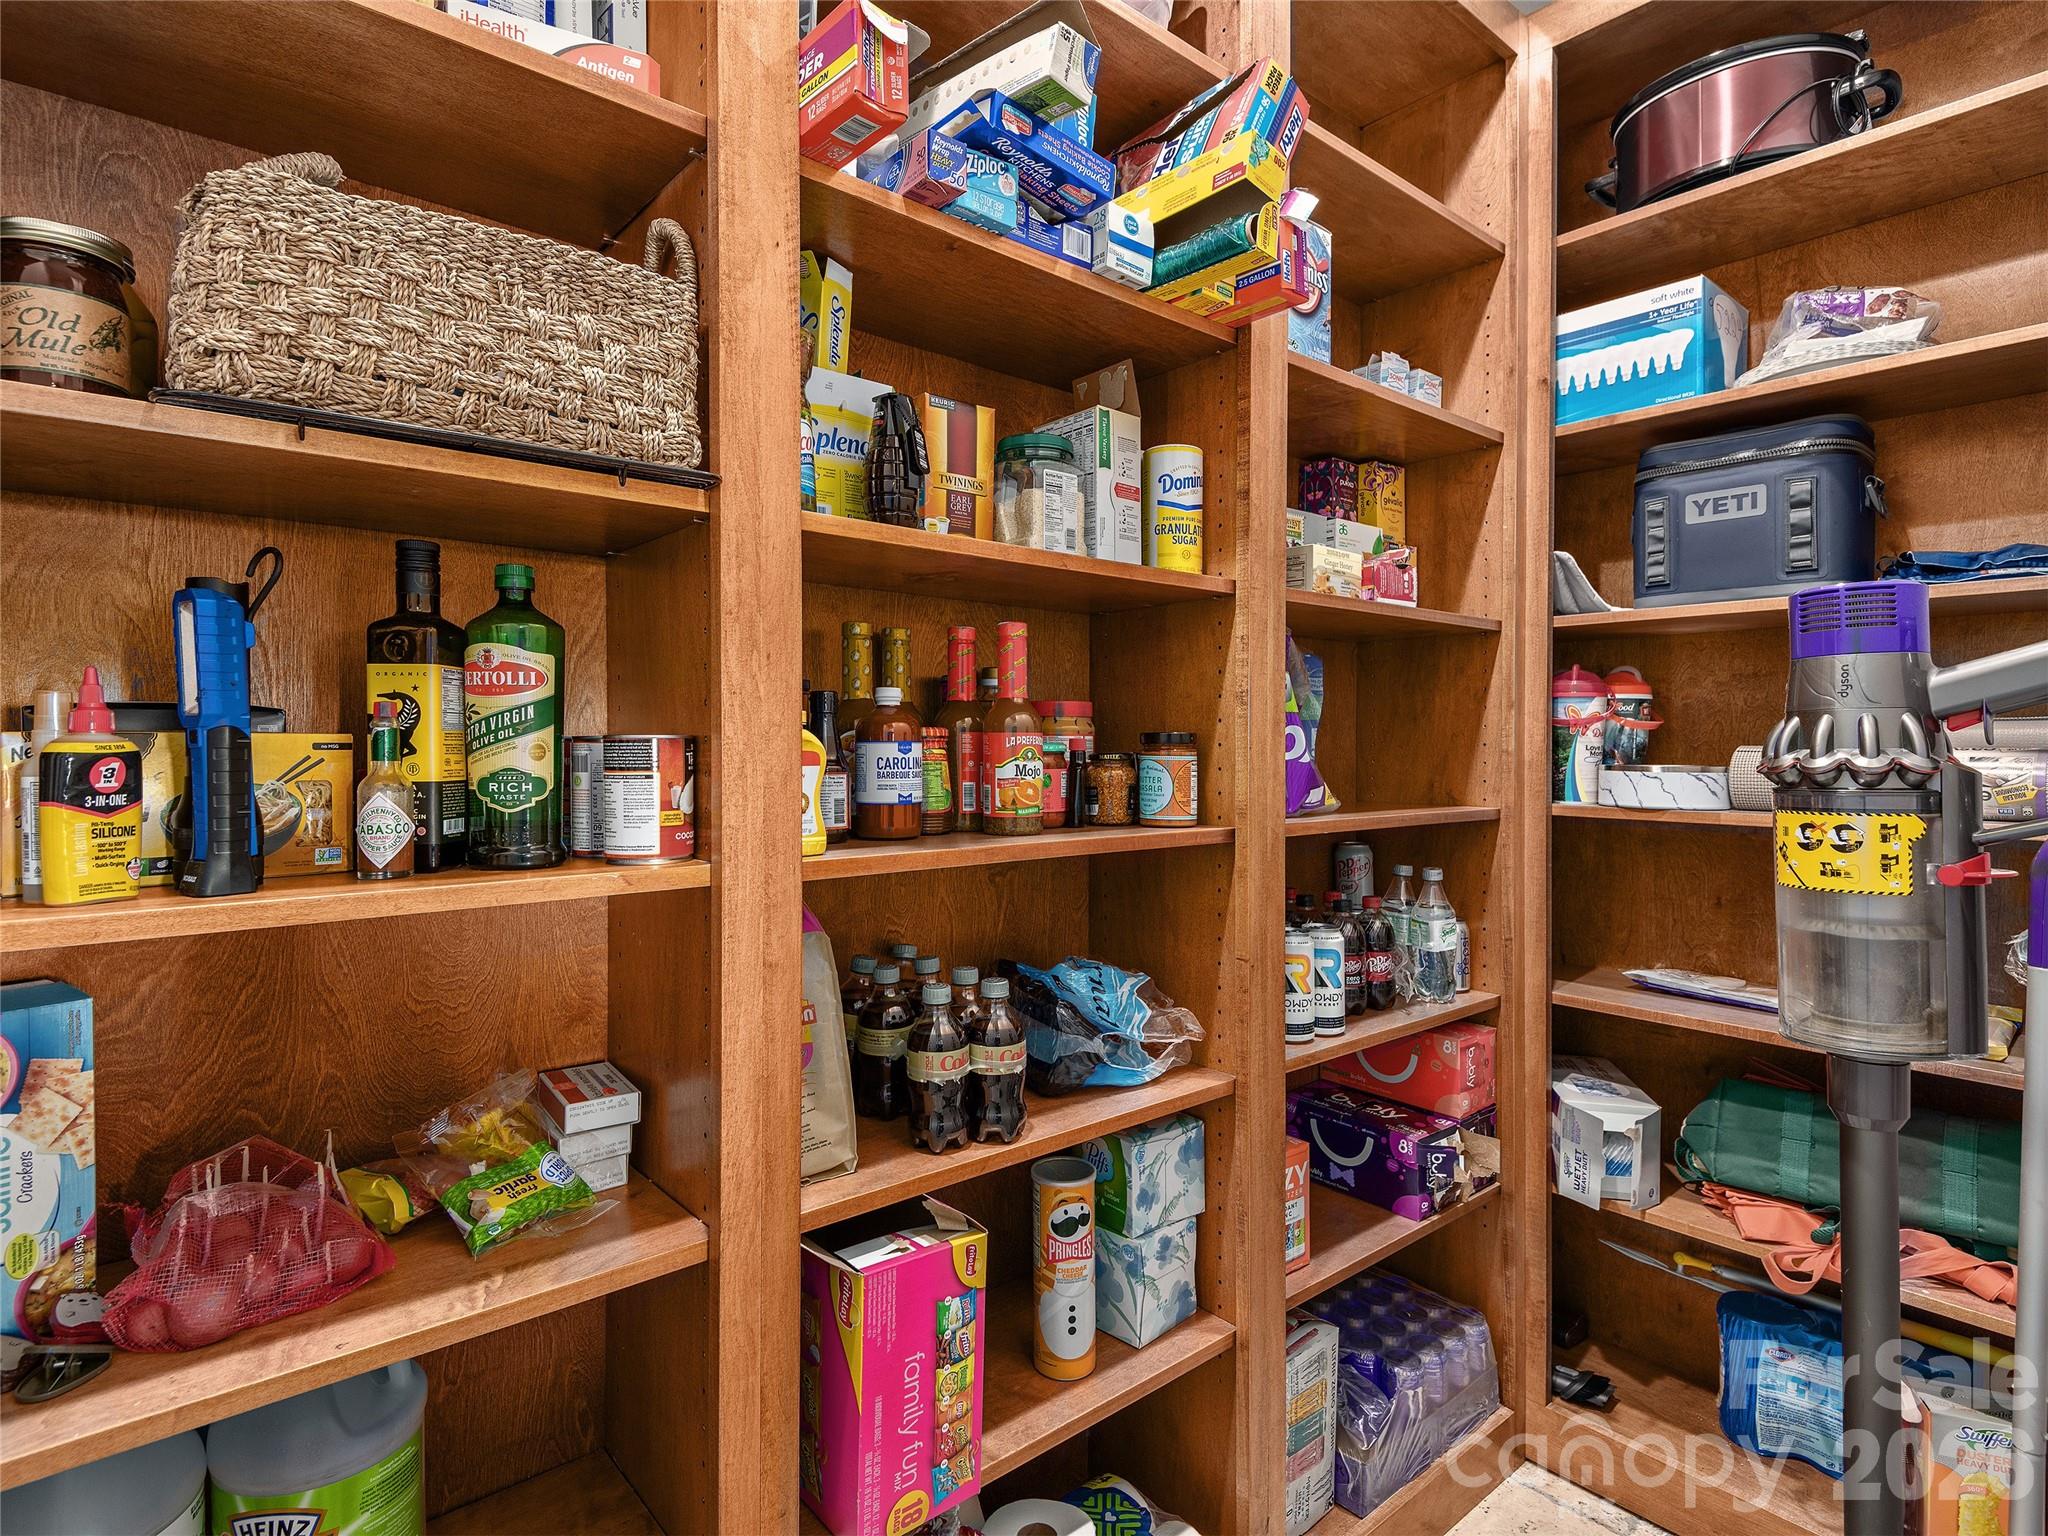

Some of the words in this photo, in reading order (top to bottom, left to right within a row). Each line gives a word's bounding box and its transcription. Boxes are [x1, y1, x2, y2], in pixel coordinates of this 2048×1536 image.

[460, 9, 526, 43] iHealth
[576, 56, 635, 84] Antigen
[1265, 65, 1277, 89] PACK
[801, 70, 829, 98] GALLON
[1270, 69, 1284, 96] MEGA
[807, 104, 816, 121] 12
[1280, 108, 1302, 157] Hefty
[931, 144, 950, 159] Wrap
[934, 135, 964, 155] Reynolds
[1062, 144, 1087, 164] Baking
[930, 152, 955, 167] HEAVY
[967, 153, 1006, 178] Ziploc
[992, 136, 1053, 177] Reynolds
[949, 171, 965, 187] 50
[1008, 156, 1056, 188] KITCHENS
[1077, 164, 1111, 192] Reynolds
[1047, 190, 1079, 213] Sheets
[1093, 208, 1107, 226] 28
[1282, 250, 1292, 283] Hefty
[1238, 278, 1248, 288] 2.5
[1248, 268, 1276, 284] GALLON
[1650, 293, 1668, 305] soft
[1669, 287, 1695, 300] white
[18, 306, 82, 334] Old
[1648, 311, 1658, 319] 1+
[1659, 304, 1679, 317] Year
[830, 294, 846, 367] Splenda
[0, 326, 88, 357] Mule
[1388, 372, 1405, 383] SONIC
[1424, 378, 1440, 389] SONIC
[930, 396, 955, 407] KEURIG
[1655, 393, 1682, 403] Directional
[811, 416, 870, 457] plen
[938, 472, 984, 492] TWININGS
[949, 493, 972, 505] EARL
[949, 501, 973, 514] GREY
[1691, 491, 1758, 517] YETI
[1172, 534, 1198, 547] SUGAR
[1836, 663, 1853, 698] dyson
[466, 719, 487, 743] XTRA
[490, 704, 535, 731] VIRGIN
[472, 733, 495, 751] OLIVE
[498, 727, 516, 740] OIL
[1005, 737, 1016, 747] LA
[103, 767, 117, 779] 3
[876, 770, 911, 779] BARBEQUE
[1014, 763, 1042, 780] Mojo
[488, 782, 534, 793] RICH
[493, 793, 526, 801] TASTE
[84, 793, 128, 808] 3-IN-ONE
[91, 825, 137, 840] SILICONE
[358, 822, 410, 835] ABASCO
[95, 860, 126, 869] Quick-Drying
[1336, 859, 1370, 880] Pepper
[1285, 997, 1314, 1009] OWDY
[1314, 992, 1344, 1004] OWDY
[1442, 1040, 1452, 1054] 8
[1466, 1046, 1476, 1088] bubly
[1397, 1138, 1408, 1154] 8
[1086, 1141, 1109, 1174] Puffs
[16, 1150, 33, 1204] Crackers
[1573, 1148, 1583, 1191] WETJET
[492, 1170, 539, 1197] garlic
[507, 1183, 539, 1201] fresh
[1580, 1171, 1588, 1195] HEAVY
[75, 1233, 87, 1252] 453g
[1048, 1236, 1092, 1260] PRINGLES
[1056, 1264, 1088, 1275] CHEDDAR
[1061, 1270, 1084, 1279] CHEESE
[1768, 1349, 1793, 1361] CLOROX
[897, 1351, 926, 1435] family
[901, 1440, 924, 1490] fun
[1957, 1448, 2011, 1465] DUSTER
[1957, 1458, 1991, 1470] HEAVY
[1993, 1463, 2012, 1475] DUT
[894, 1471, 902, 1493] MIX
[892, 1508, 901, 1534] BAGS
[900, 1496, 924, 1529] 18
[237, 1513, 312, 1536] HEINZ
